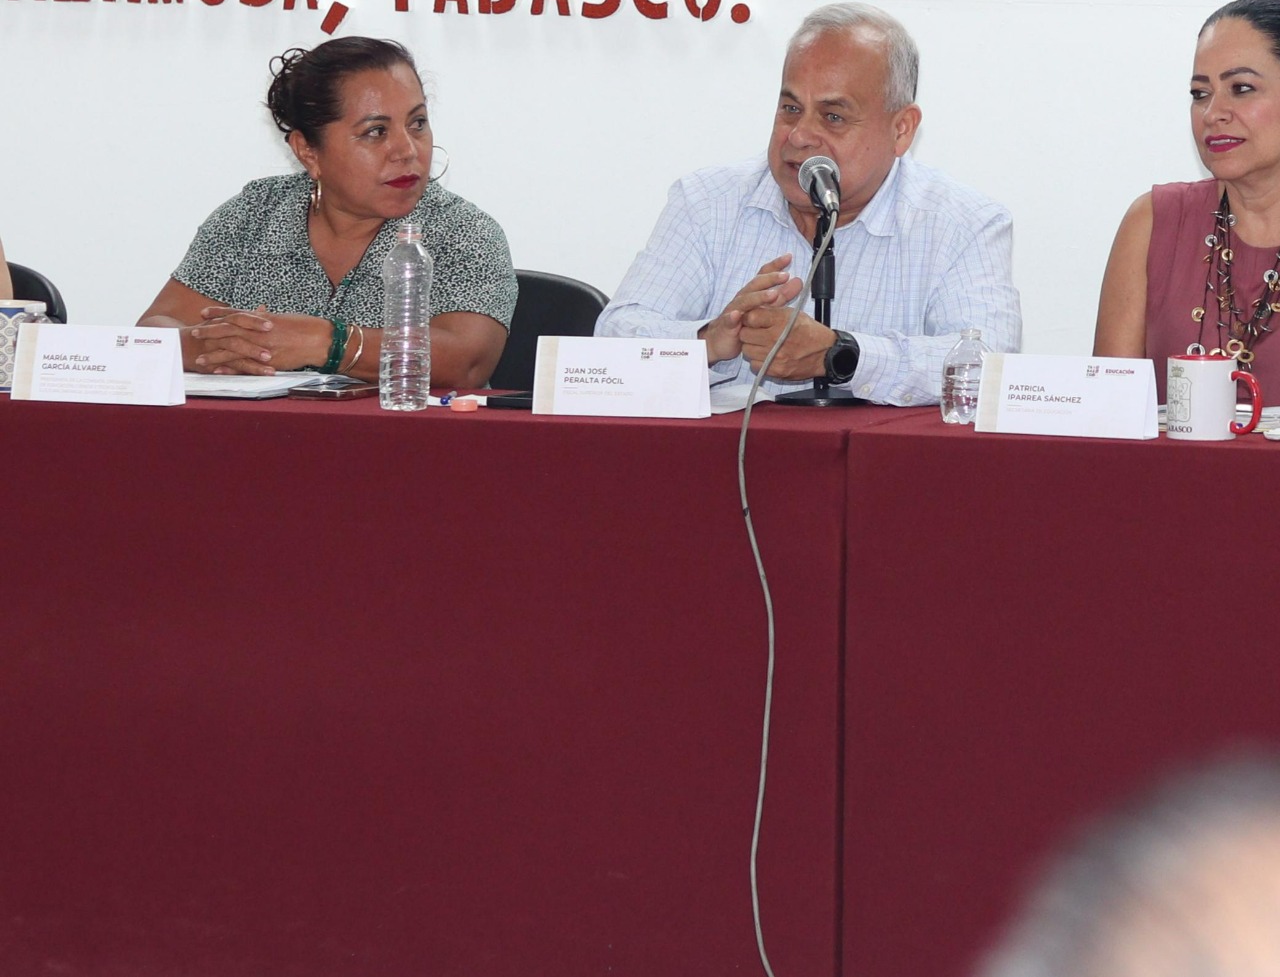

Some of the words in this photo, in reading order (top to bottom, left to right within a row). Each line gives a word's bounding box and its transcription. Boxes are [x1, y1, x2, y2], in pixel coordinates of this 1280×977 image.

[43, 353, 68, 361] MARÍA
[70, 354, 90, 362] FÉLIX
[72, 364, 107, 372] ÁLVAREZ
[587, 367, 608, 375] JOSÉ
[564, 376, 600, 384] PERALTA
[601, 376, 624, 385] FÓCIL
[1008, 384, 1045, 392] PATRICIA
[1007, 394, 1042, 402] IPARREA
[1044, 394, 1082, 404] SÁNCHEZ
